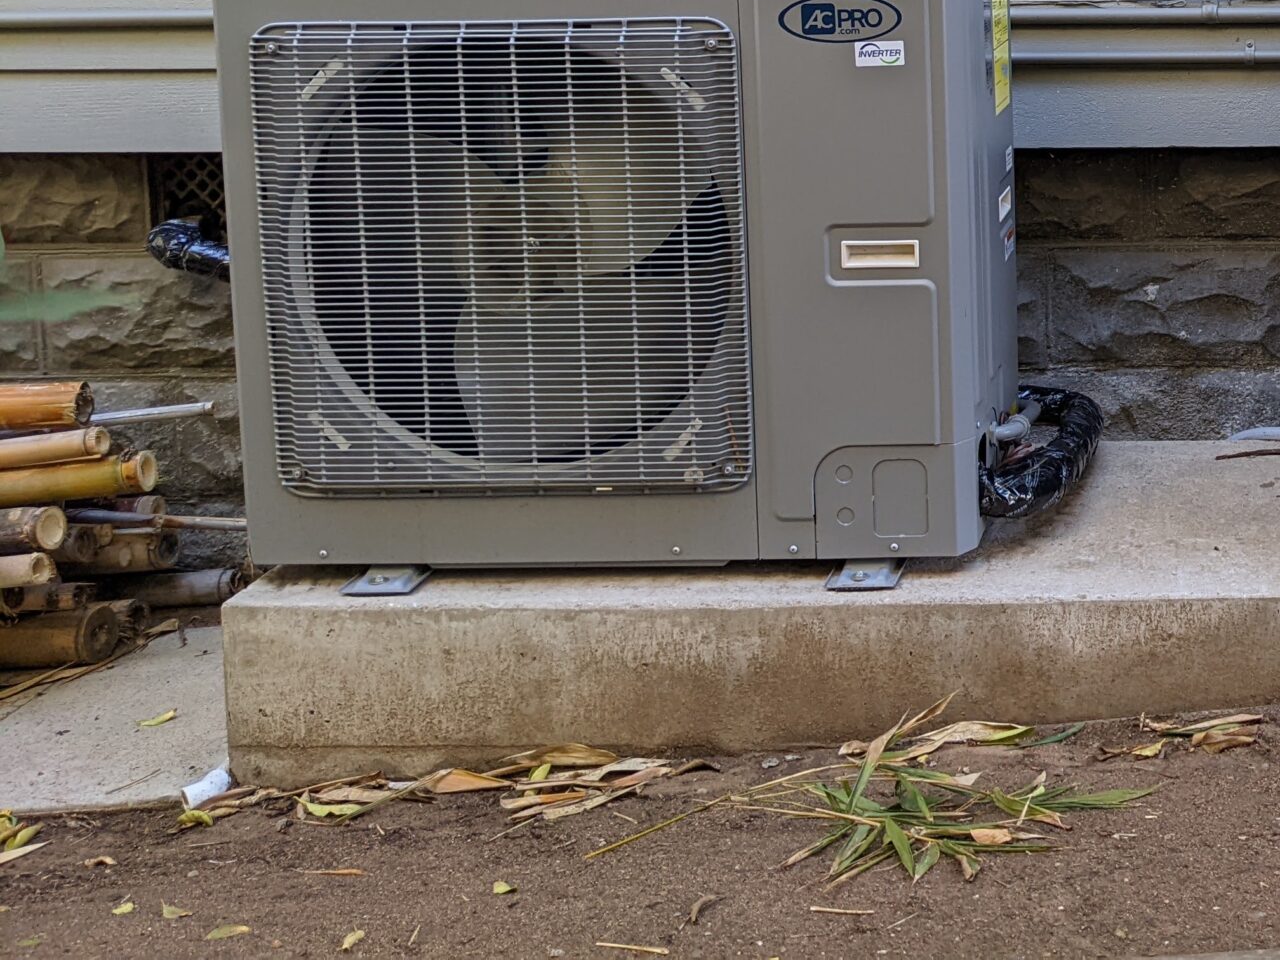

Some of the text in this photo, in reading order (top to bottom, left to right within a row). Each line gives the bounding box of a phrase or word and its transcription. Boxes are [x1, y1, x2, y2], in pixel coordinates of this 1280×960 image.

[837, 7, 883, 28] PRO
[837, 27, 861, 35] .com
[858, 48, 902, 58] INVERTER
